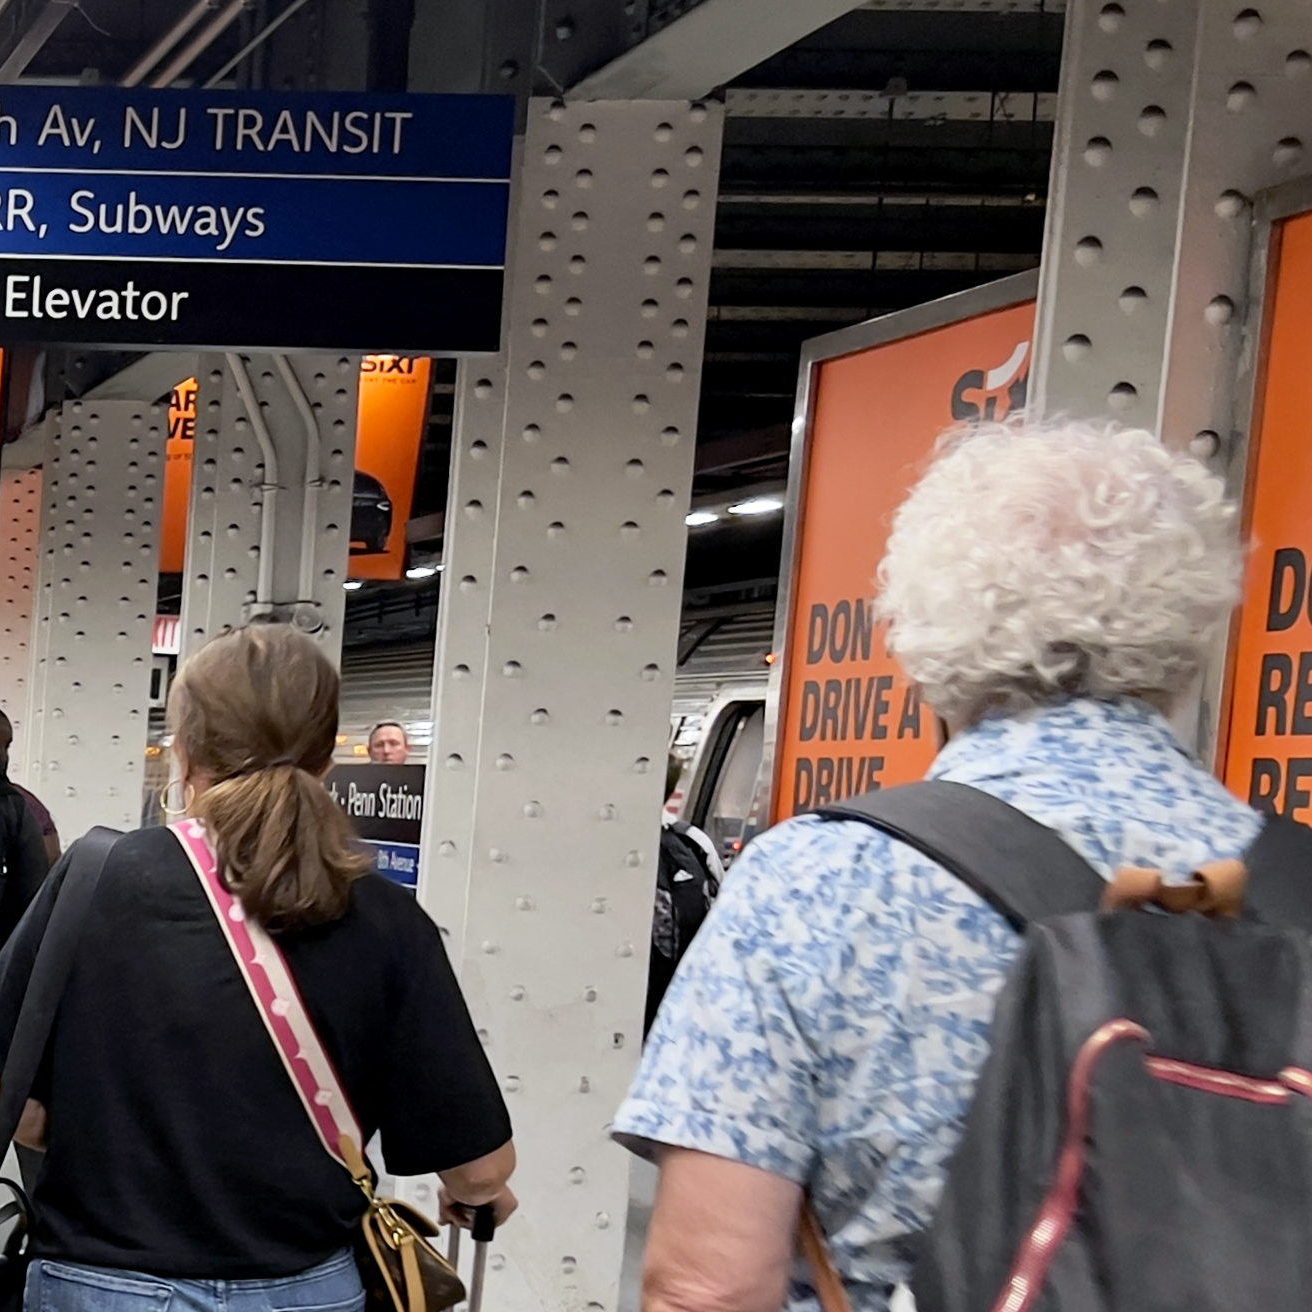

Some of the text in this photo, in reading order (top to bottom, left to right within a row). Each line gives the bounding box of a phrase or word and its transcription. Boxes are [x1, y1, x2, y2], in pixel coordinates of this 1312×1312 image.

[37, 106, 103, 154] Av,
[123, 107, 187, 149] NJ
[208, 108, 413, 154] TRANSIT
[69, 191, 266, 250] Subways
[5, 276, 189, 322] Elevator
[799, 676, 921, 741] DRIVE A
[347, 782, 376, 817] Penn
[378, 783, 422, 820] Station
